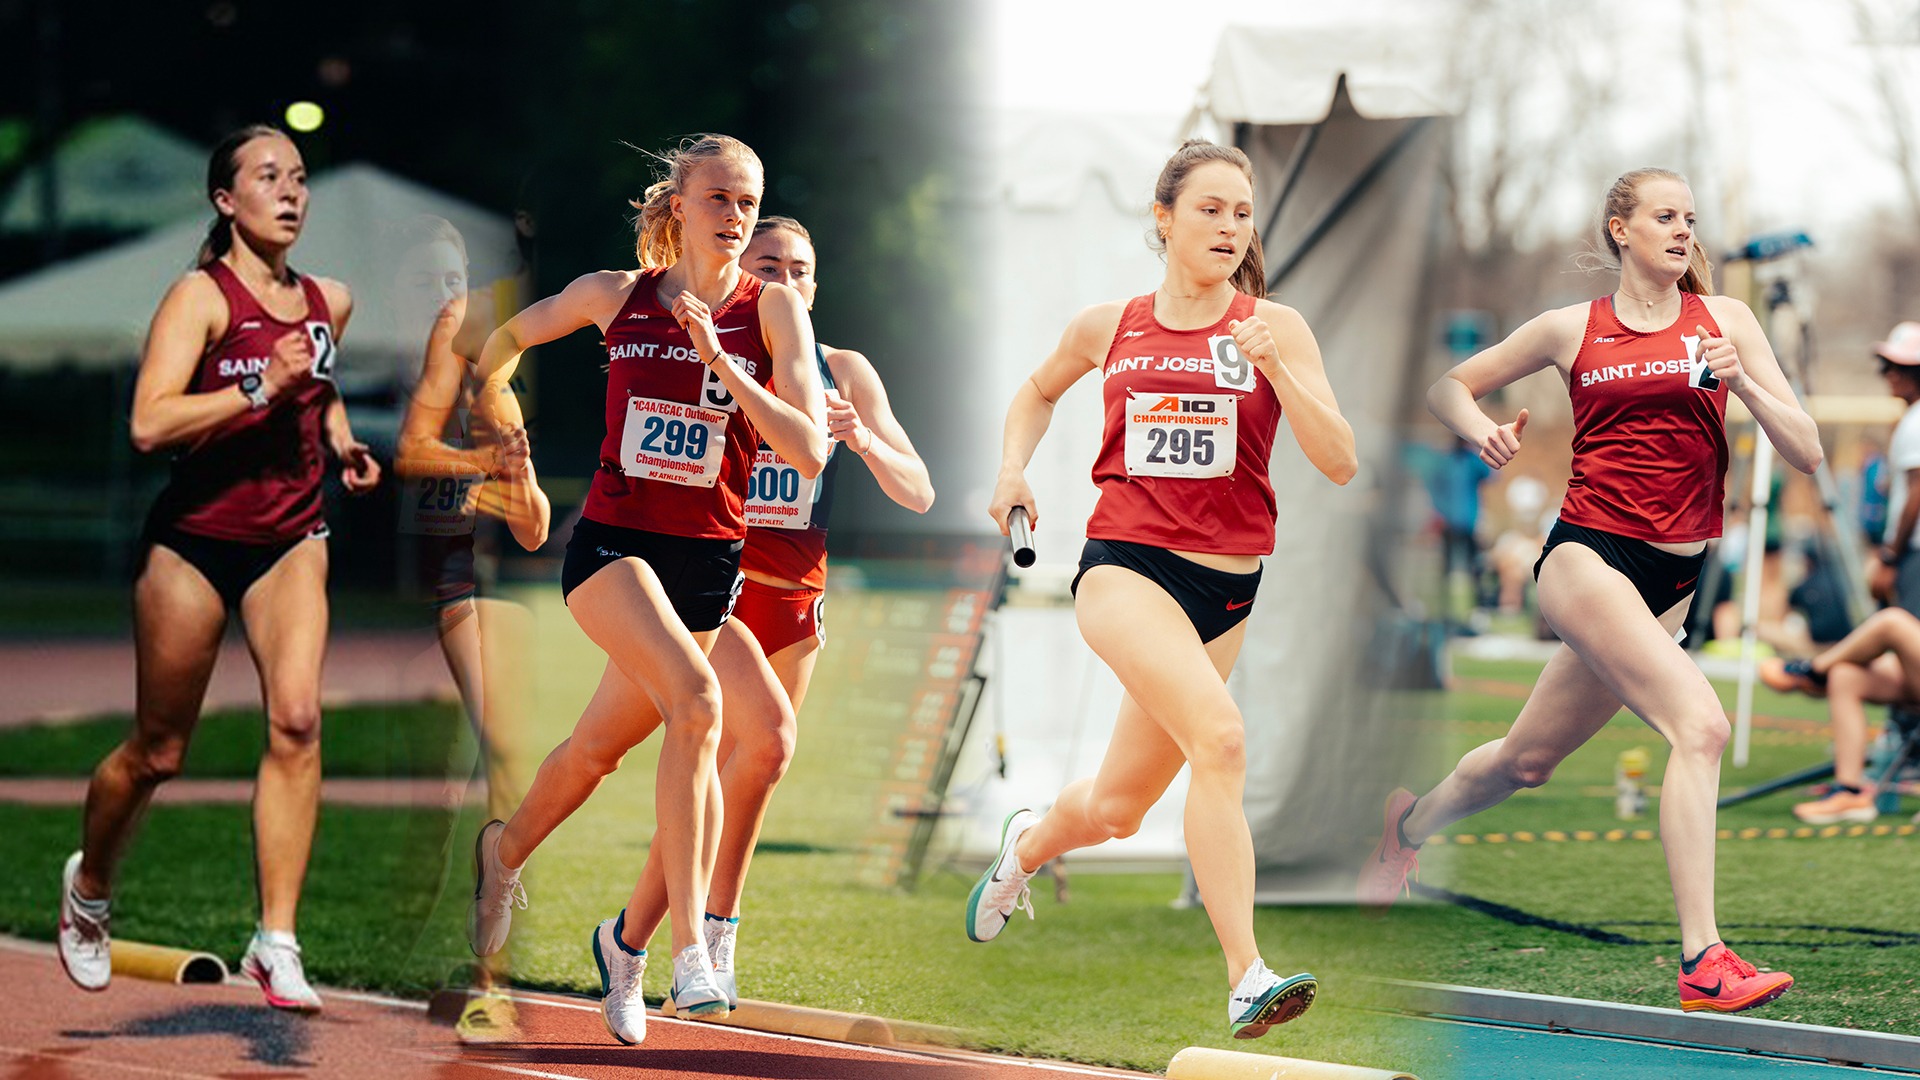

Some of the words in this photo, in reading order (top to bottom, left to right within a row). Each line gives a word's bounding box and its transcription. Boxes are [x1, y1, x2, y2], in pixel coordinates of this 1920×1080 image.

[313, 325, 332, 374] 2
[610, 343, 659, 361] SAINT
[218, 357, 269, 376] SAIN
[1154, 357, 1215, 374] JOSE
[1216, 338, 1248, 386] 9
[1581, 363, 1636, 387] SAINT
[1640, 359, 1690, 376] JOSE
[1149, 396, 1215, 413] A10
[684, 407, 722, 424] Outdoor
[1133, 414, 1229, 426] CHAMPIONSHIPS
[640, 416, 709, 460] 299
[1146, 427, 1215, 466] 295
[635, 453, 705, 475] Championships
[659, 473, 688, 483] ATHLETIC
[747, 466, 800, 503] 500
[745, 504, 799, 516] ampionships
